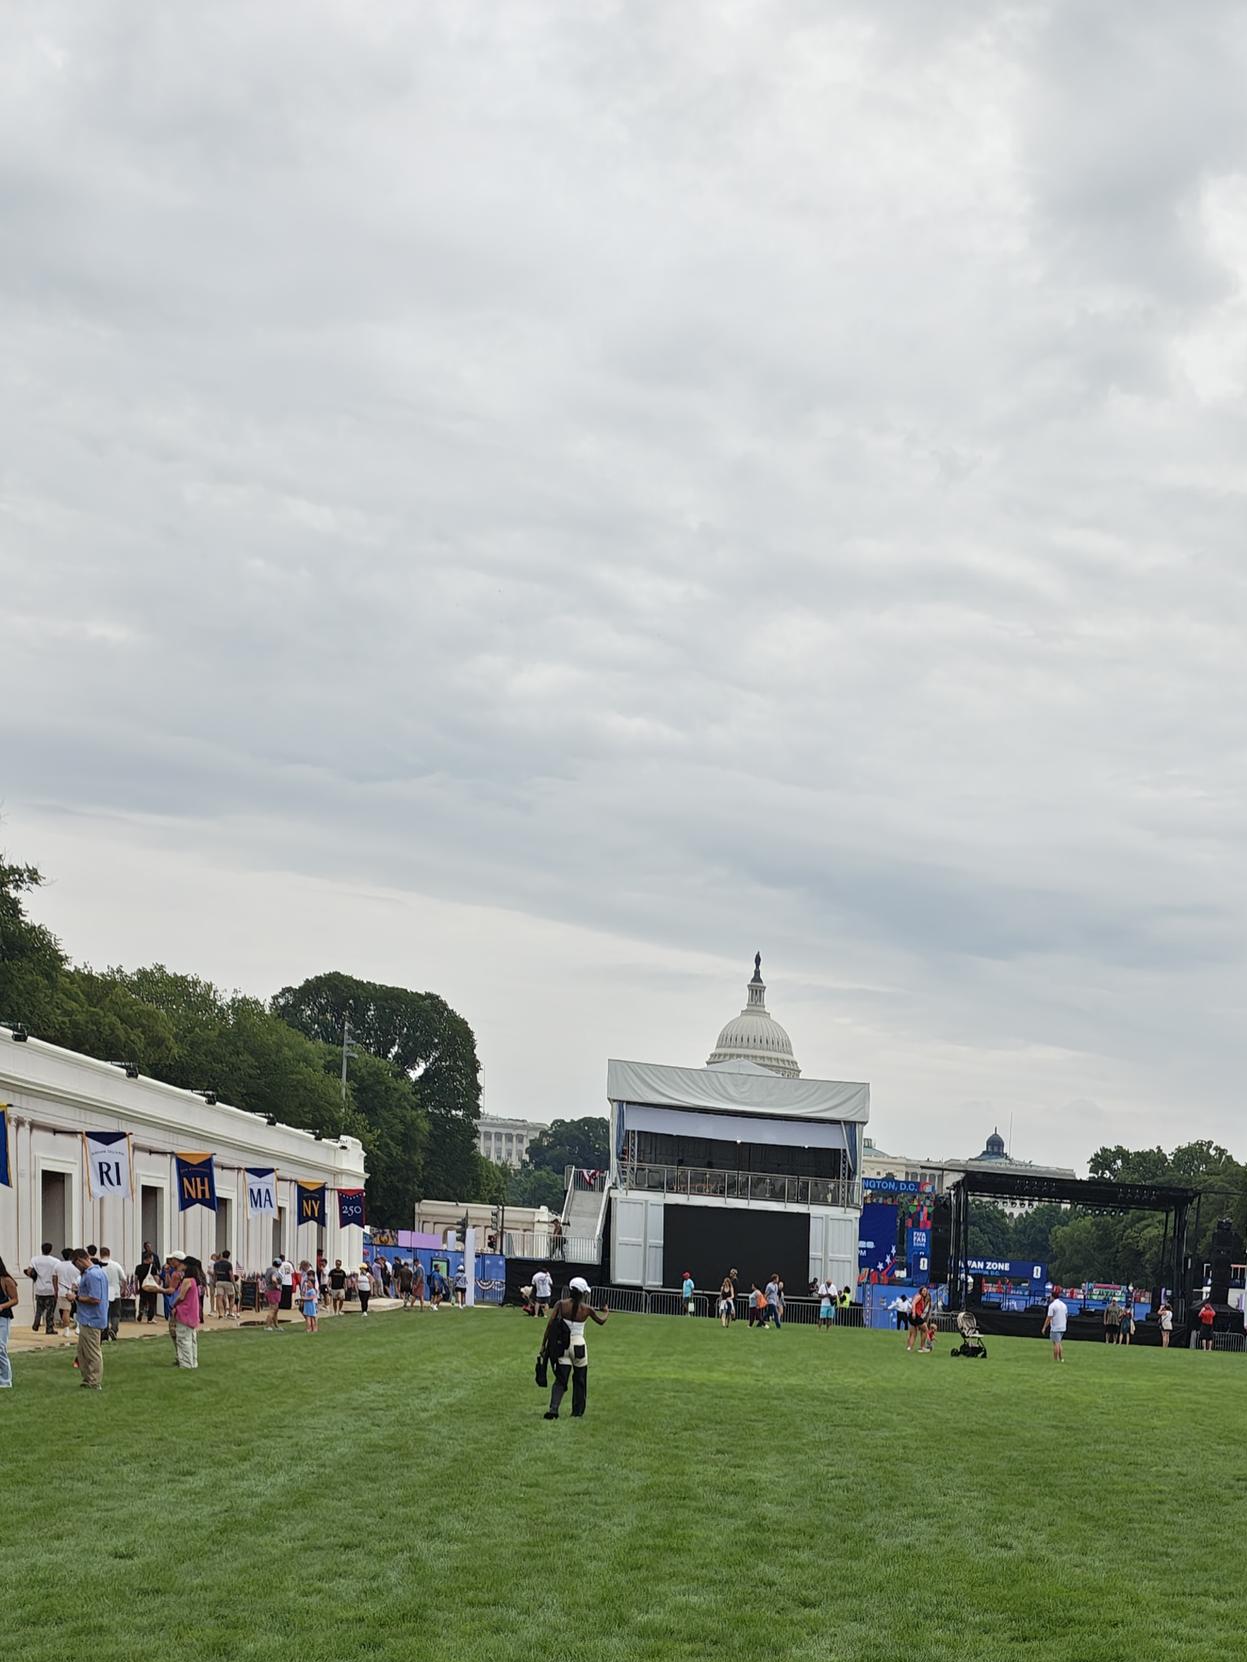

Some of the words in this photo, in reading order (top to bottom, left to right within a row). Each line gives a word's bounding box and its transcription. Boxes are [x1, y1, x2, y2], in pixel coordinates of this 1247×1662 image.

[98, 1161, 121, 1187] RI
[183, 1176, 211, 1199] NH
[249, 1188, 274, 1209] MA
[303, 1200, 321, 1217] NY
[342, 1205, 362, 1217] 250
[986, 1262, 1010, 1271] ZONE
